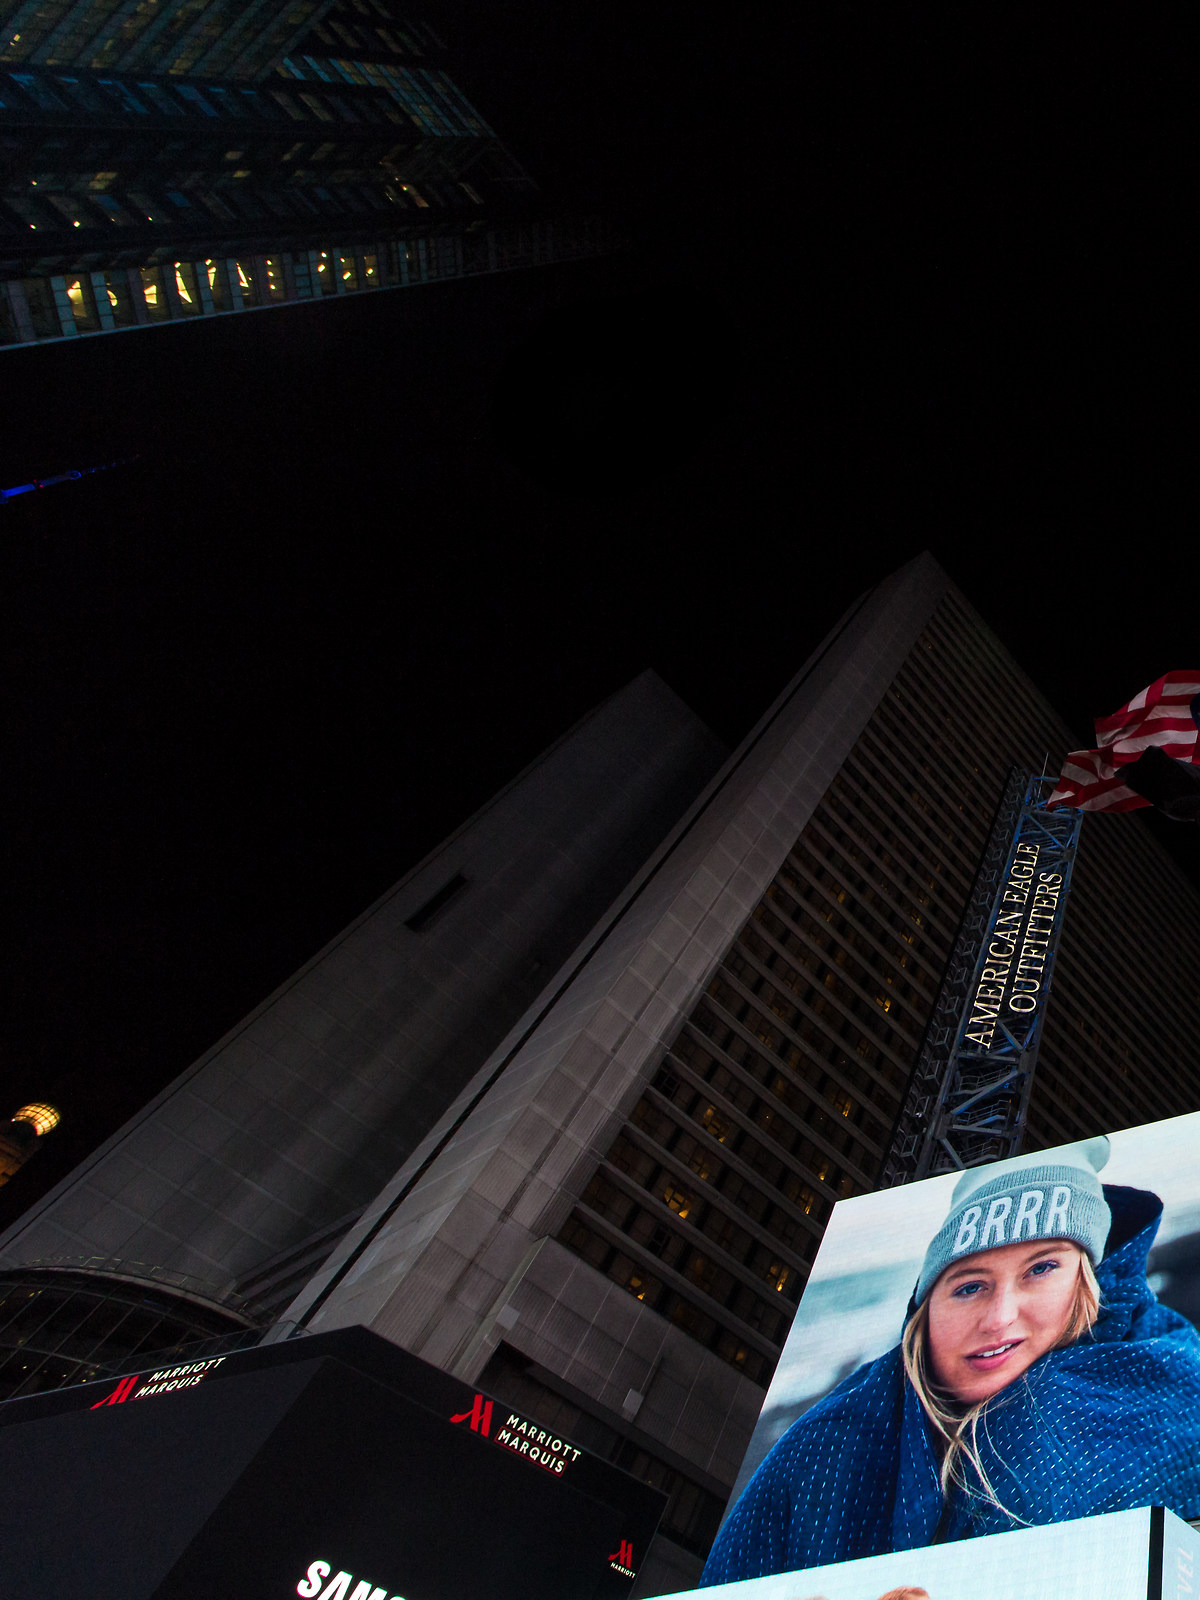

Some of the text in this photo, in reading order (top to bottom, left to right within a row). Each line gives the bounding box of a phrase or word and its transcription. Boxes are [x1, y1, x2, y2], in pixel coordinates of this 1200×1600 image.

[965, 842, 1040, 1049] AMERICAN EAGLE
[1009, 872, 1063, 1014] OUTFITTERS
[951, 1186, 1073, 1256] BRRR
[134, 1374, 204, 1398] MARQUIS
[148, 1356, 227, 1383] MARRIOTT
[497, 1429, 565, 1473] MARQUIS
[505, 1414, 582, 1462] MARRIOTT
[610, 1562, 636, 1579] MARRIOTT
